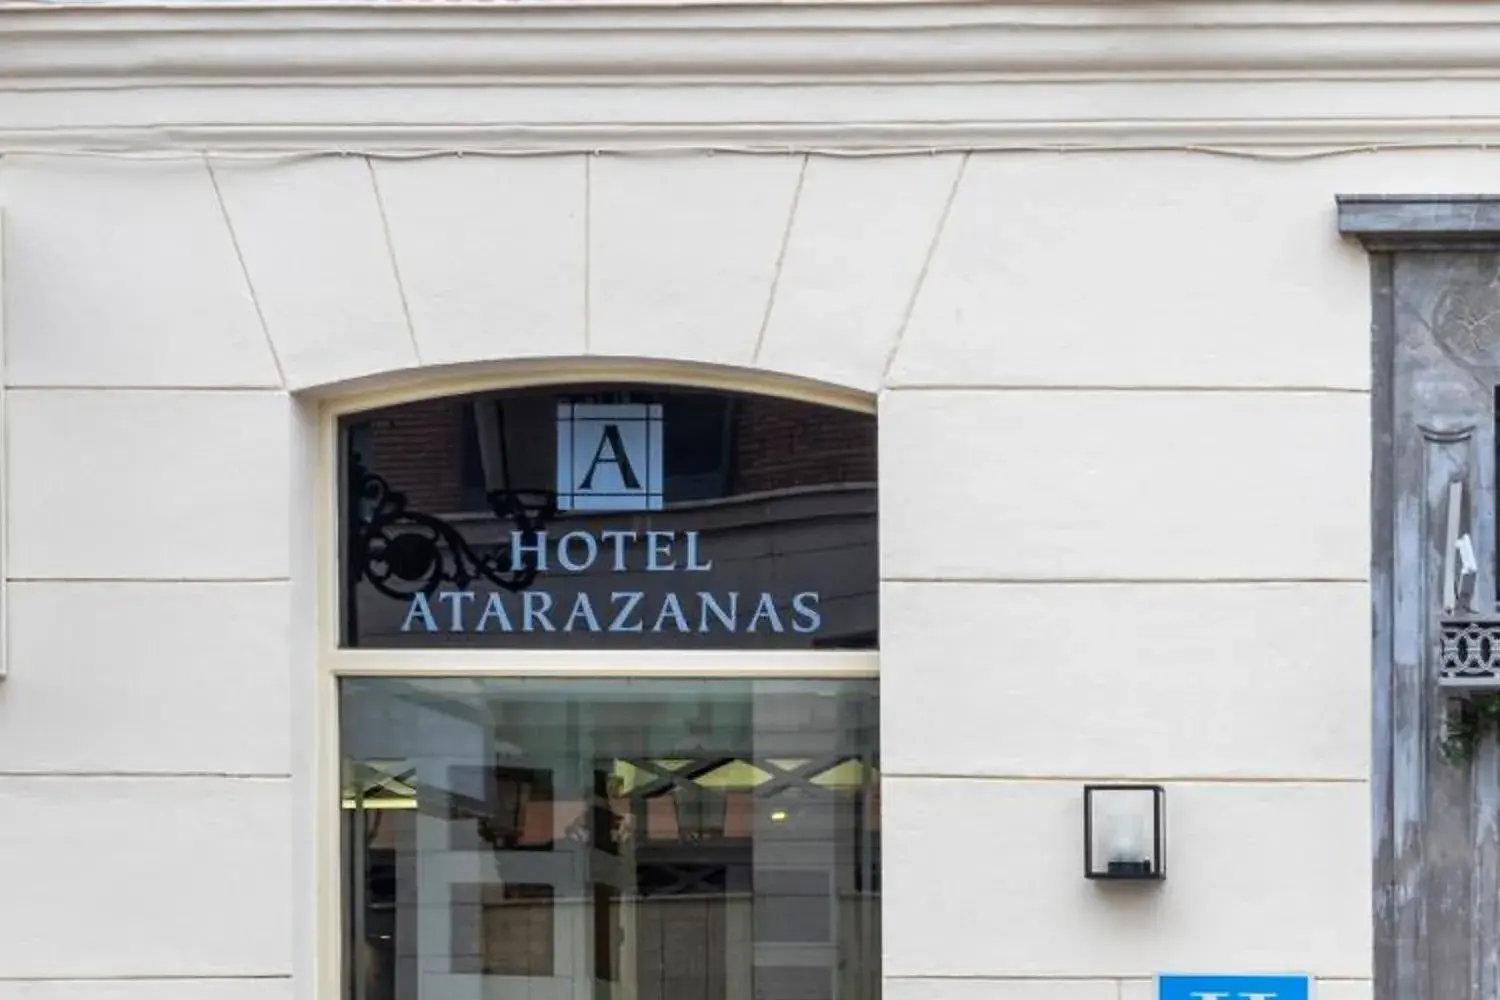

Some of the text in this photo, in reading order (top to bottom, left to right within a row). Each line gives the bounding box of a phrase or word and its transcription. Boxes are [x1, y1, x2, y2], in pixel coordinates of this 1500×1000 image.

[580, 424, 641, 490] A
[510, 531, 712, 571] HOTEL
[401, 592, 820, 632] ATARAZANAS
